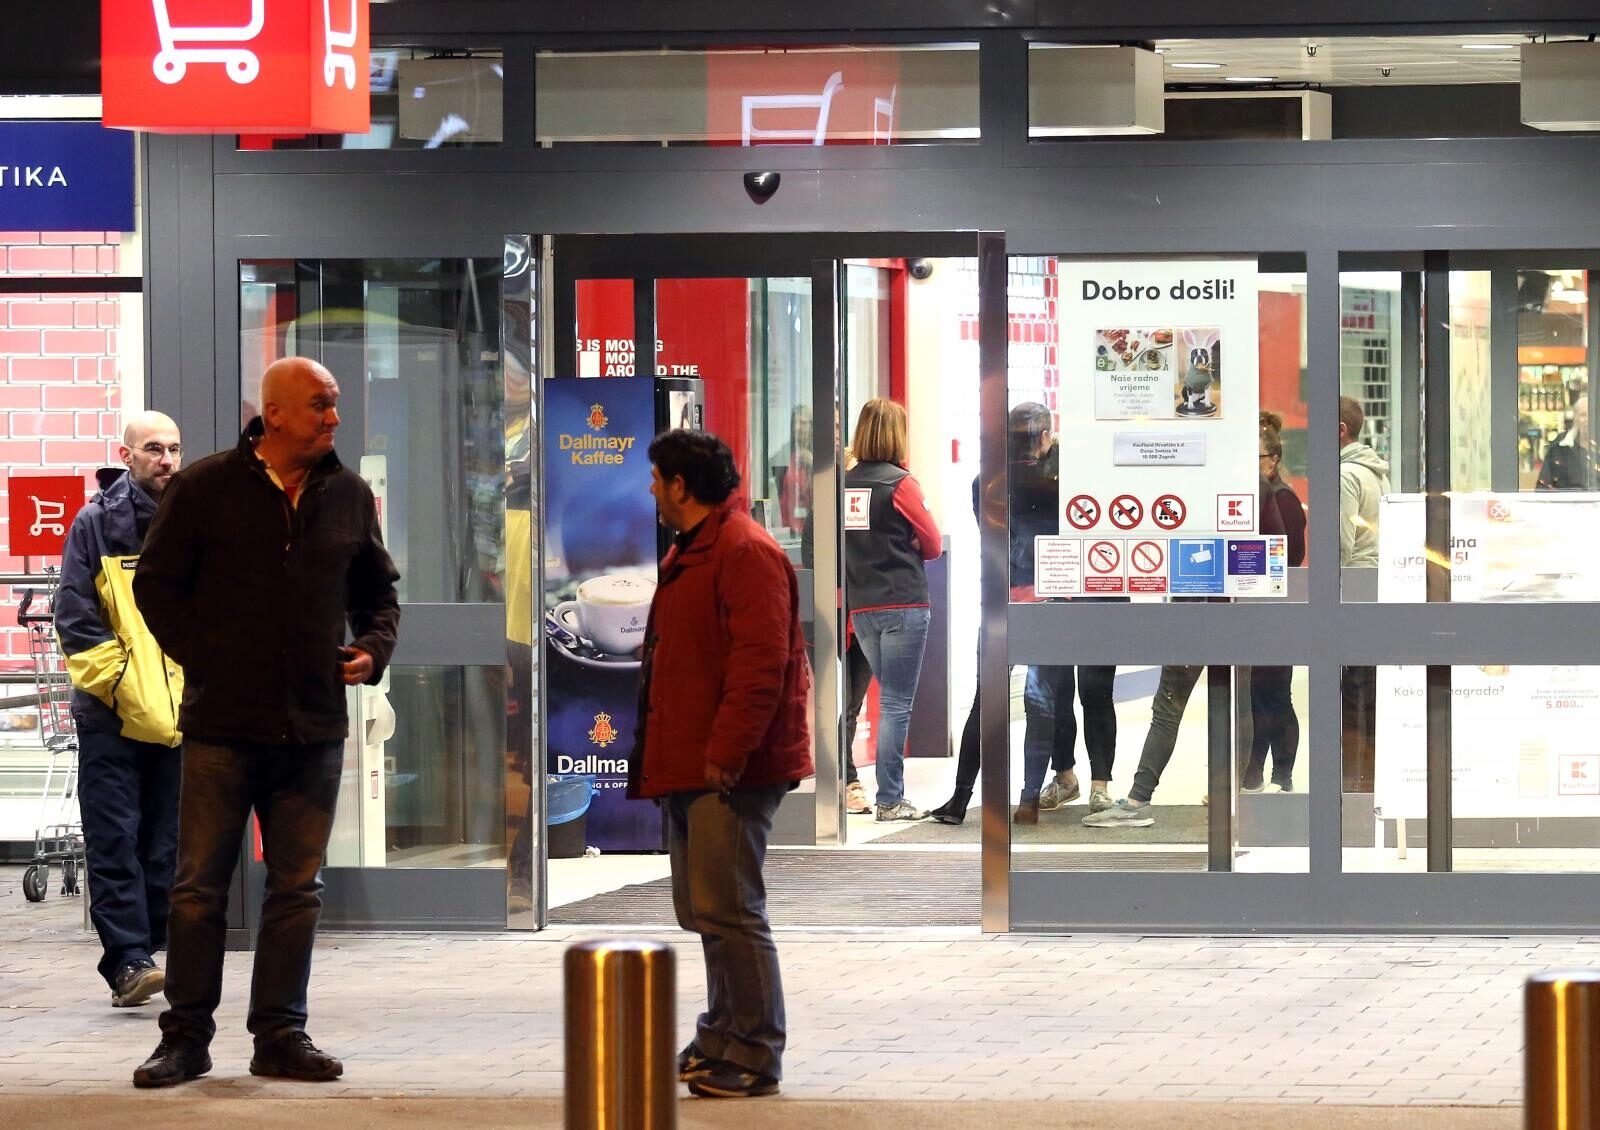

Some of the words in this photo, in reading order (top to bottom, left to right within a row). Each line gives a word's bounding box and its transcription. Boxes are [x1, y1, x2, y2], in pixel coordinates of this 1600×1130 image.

[1082, 279, 1161, 301] Dobro
[1169, 279, 1235, 301] došli!
[587, 339, 601, 352] IS
[671, 364, 699, 377] THE
[1111, 374, 1132, 383] Naše
[1134, 374, 1160, 383] radno
[1119, 384, 1151, 393] vrijeme
[559, 434, 636, 452] Dallmayr
[572, 451, 624, 465] Kaffee
[1394, 687, 1425, 697] Kako
